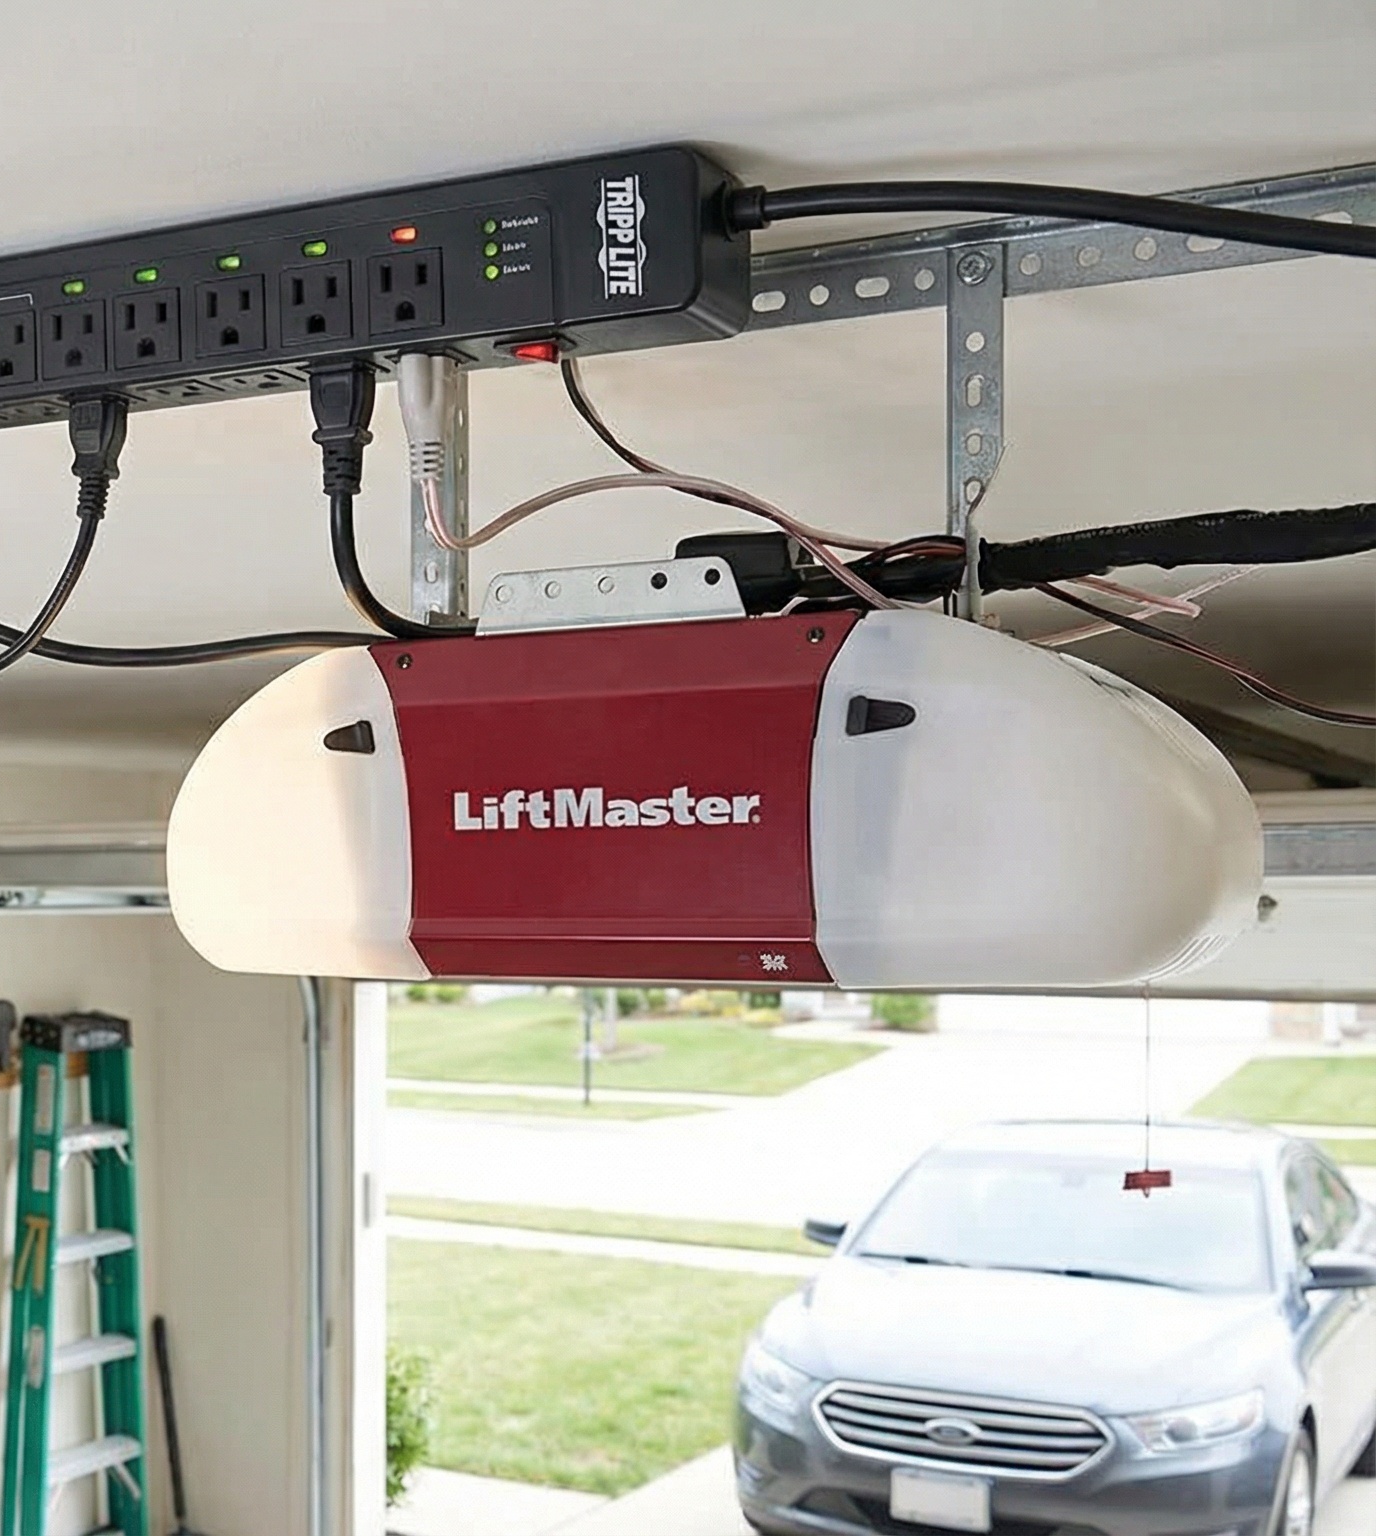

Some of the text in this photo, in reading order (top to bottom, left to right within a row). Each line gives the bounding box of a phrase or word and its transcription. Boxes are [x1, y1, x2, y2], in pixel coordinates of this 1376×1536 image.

[606, 176, 637, 295] TRIPP LITE
[453, 785, 761, 831] LiftMaster
